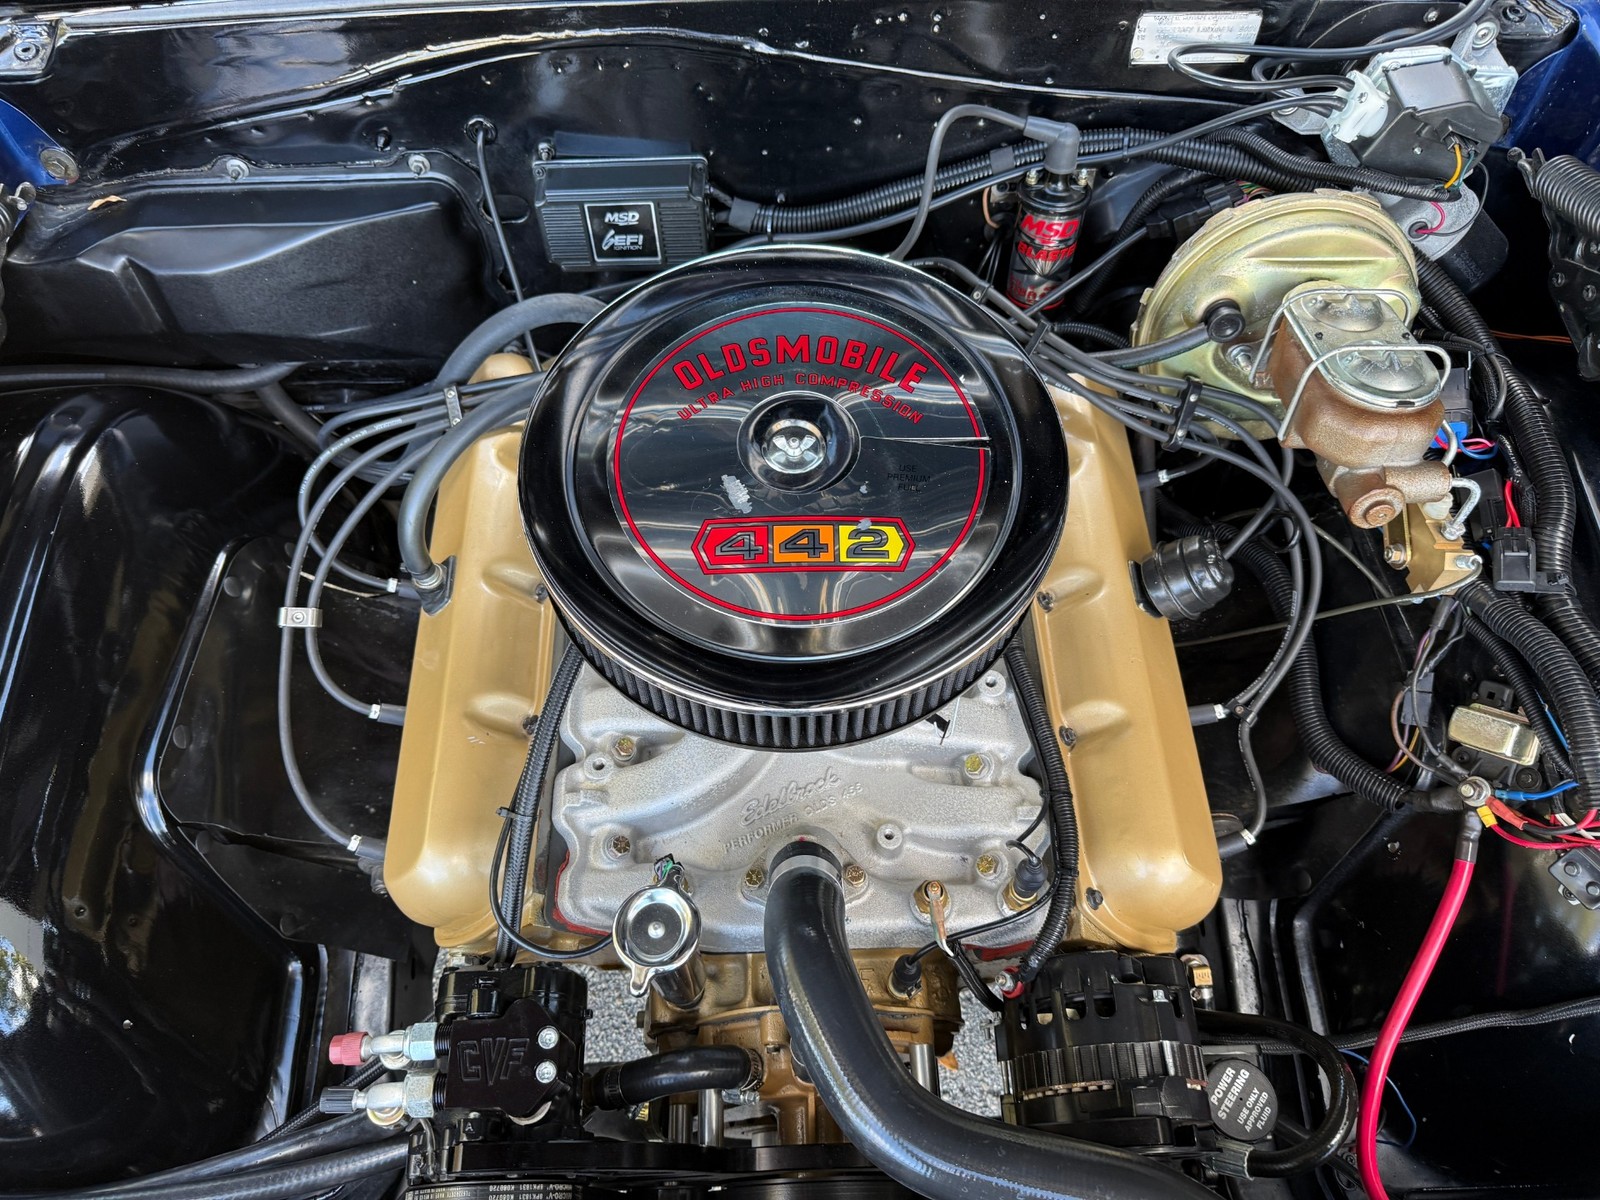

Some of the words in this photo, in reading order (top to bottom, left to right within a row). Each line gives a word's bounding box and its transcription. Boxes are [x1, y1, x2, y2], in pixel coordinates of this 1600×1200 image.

[604, 211, 640, 223] MSD
[1020, 213, 1080, 239] MSD
[672, 335, 929, 394] OLDSMOBILE
[677, 386, 735, 421] ULTRA
[740, 374, 785, 392] HIGH
[795, 373, 924, 424] COMPRESSION
[887, 473, 931, 483] PREMIUM
[897, 483, 921, 492] FUEL
[899, 464, 917, 473] USE
[741, 766, 841, 827] Edelbrock
[722, 812, 799, 853] PERFORMER
[804, 795, 837, 817] OLDS
[842, 782, 864, 799] 455
[457, 1037, 530, 1086] CVF
[1210, 1067, 1236, 1105] POWER
[1217, 1068, 1250, 1120] STEERING
[1237, 1107, 1250, 1125] USE
[1246, 1087, 1260, 1108] ONLY
[1244, 1091, 1269, 1133] APPROVED
[1256, 1106, 1272, 1130] FLUID
